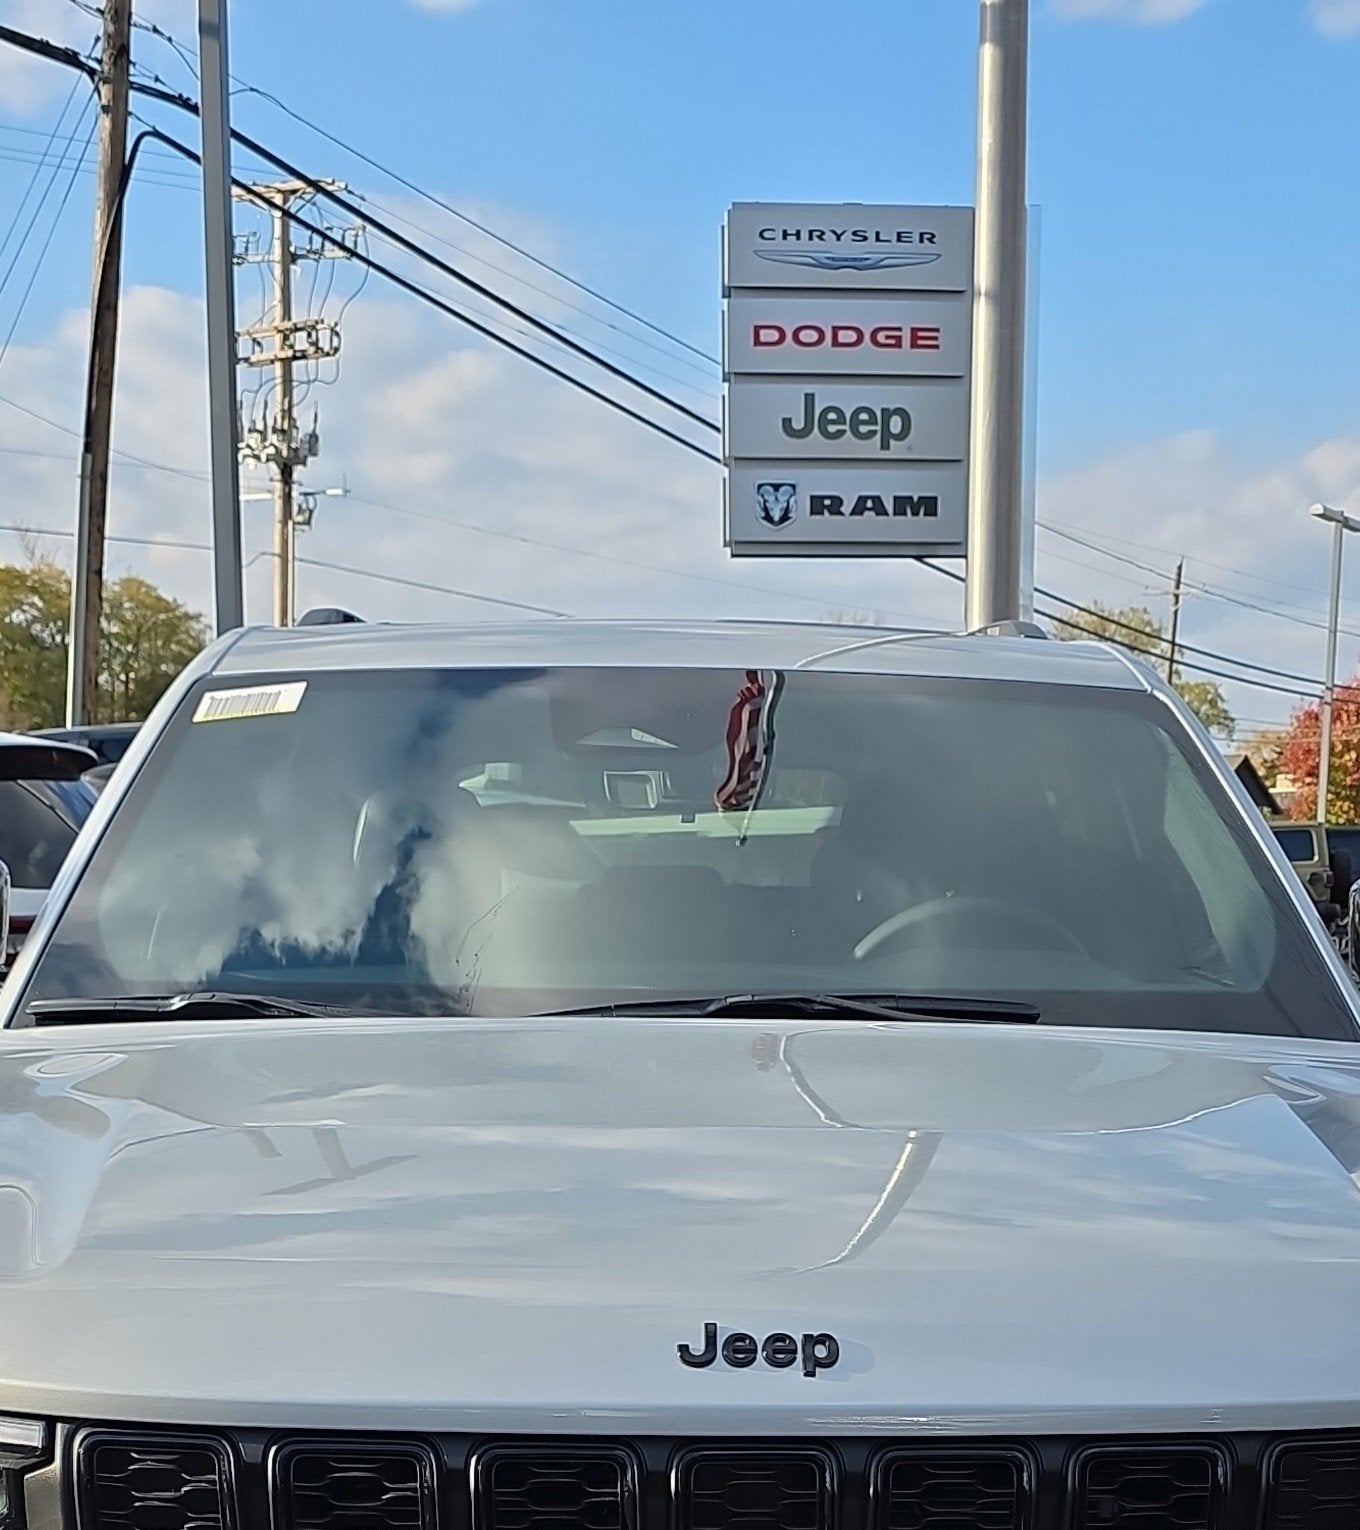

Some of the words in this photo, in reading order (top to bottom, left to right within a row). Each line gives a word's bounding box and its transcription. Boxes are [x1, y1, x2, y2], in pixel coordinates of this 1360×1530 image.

[758, 228, 937, 245] CHRYSLER
[752, 324, 941, 349] DODGE
[780, 392, 912, 451] Jeep
[808, 494, 939, 517] RAM
[676, 1322, 840, 1378] Jeep
